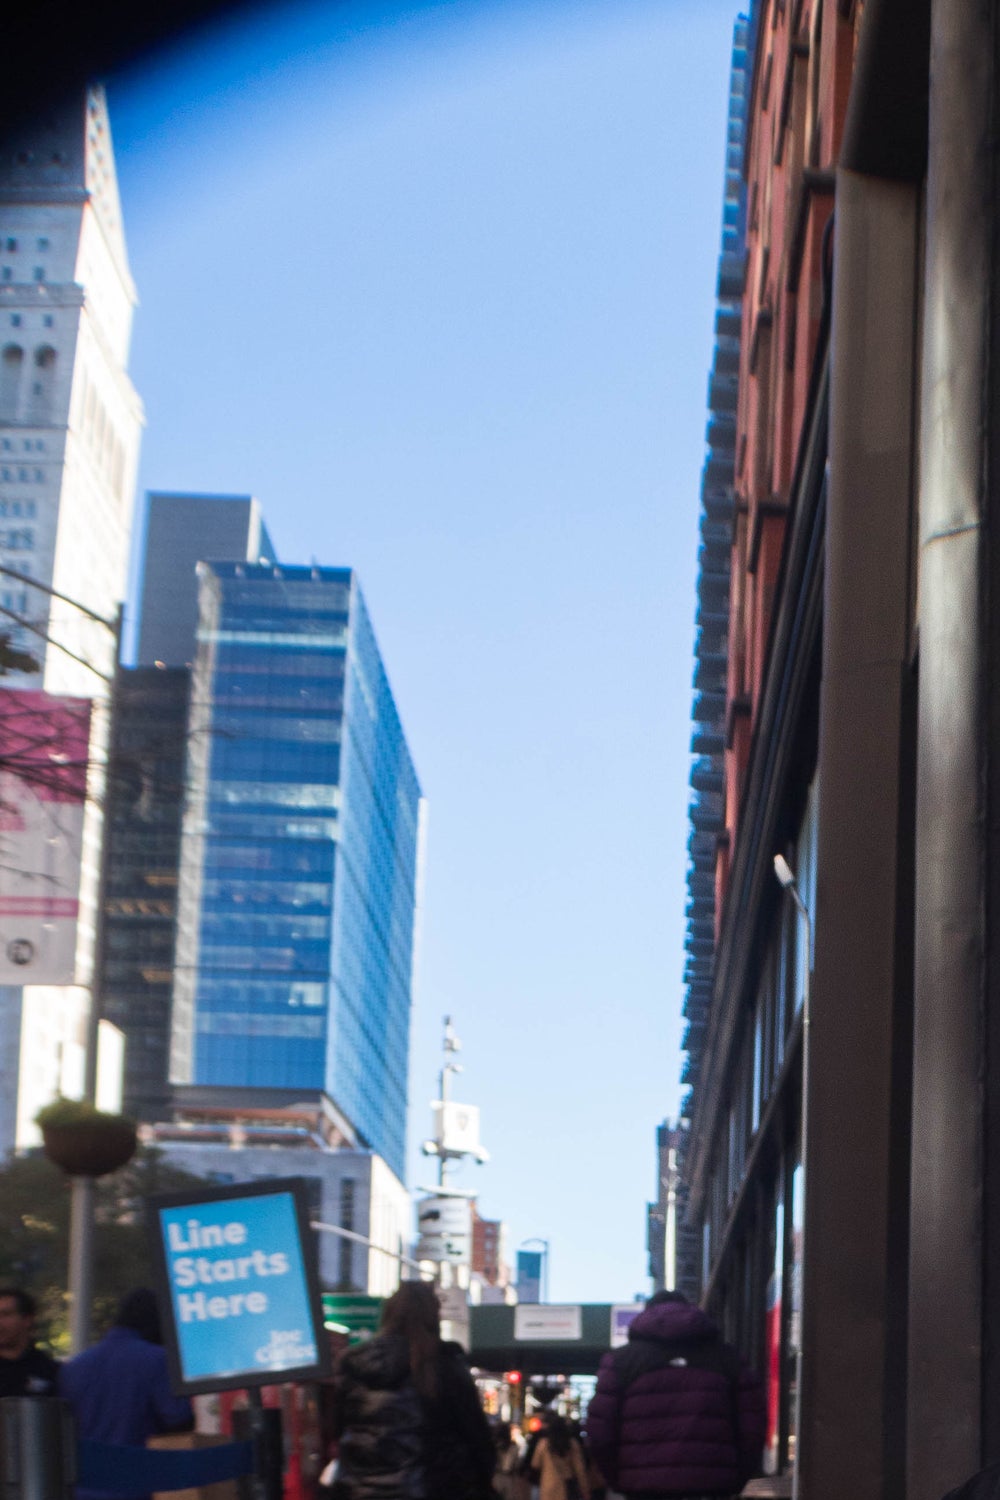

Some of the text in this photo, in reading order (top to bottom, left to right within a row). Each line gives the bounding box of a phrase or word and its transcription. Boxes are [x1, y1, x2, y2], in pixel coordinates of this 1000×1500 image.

[168, 1219, 247, 1251] Line
[173, 1250, 290, 1287] Starts
[177, 1291, 268, 1322] Here
